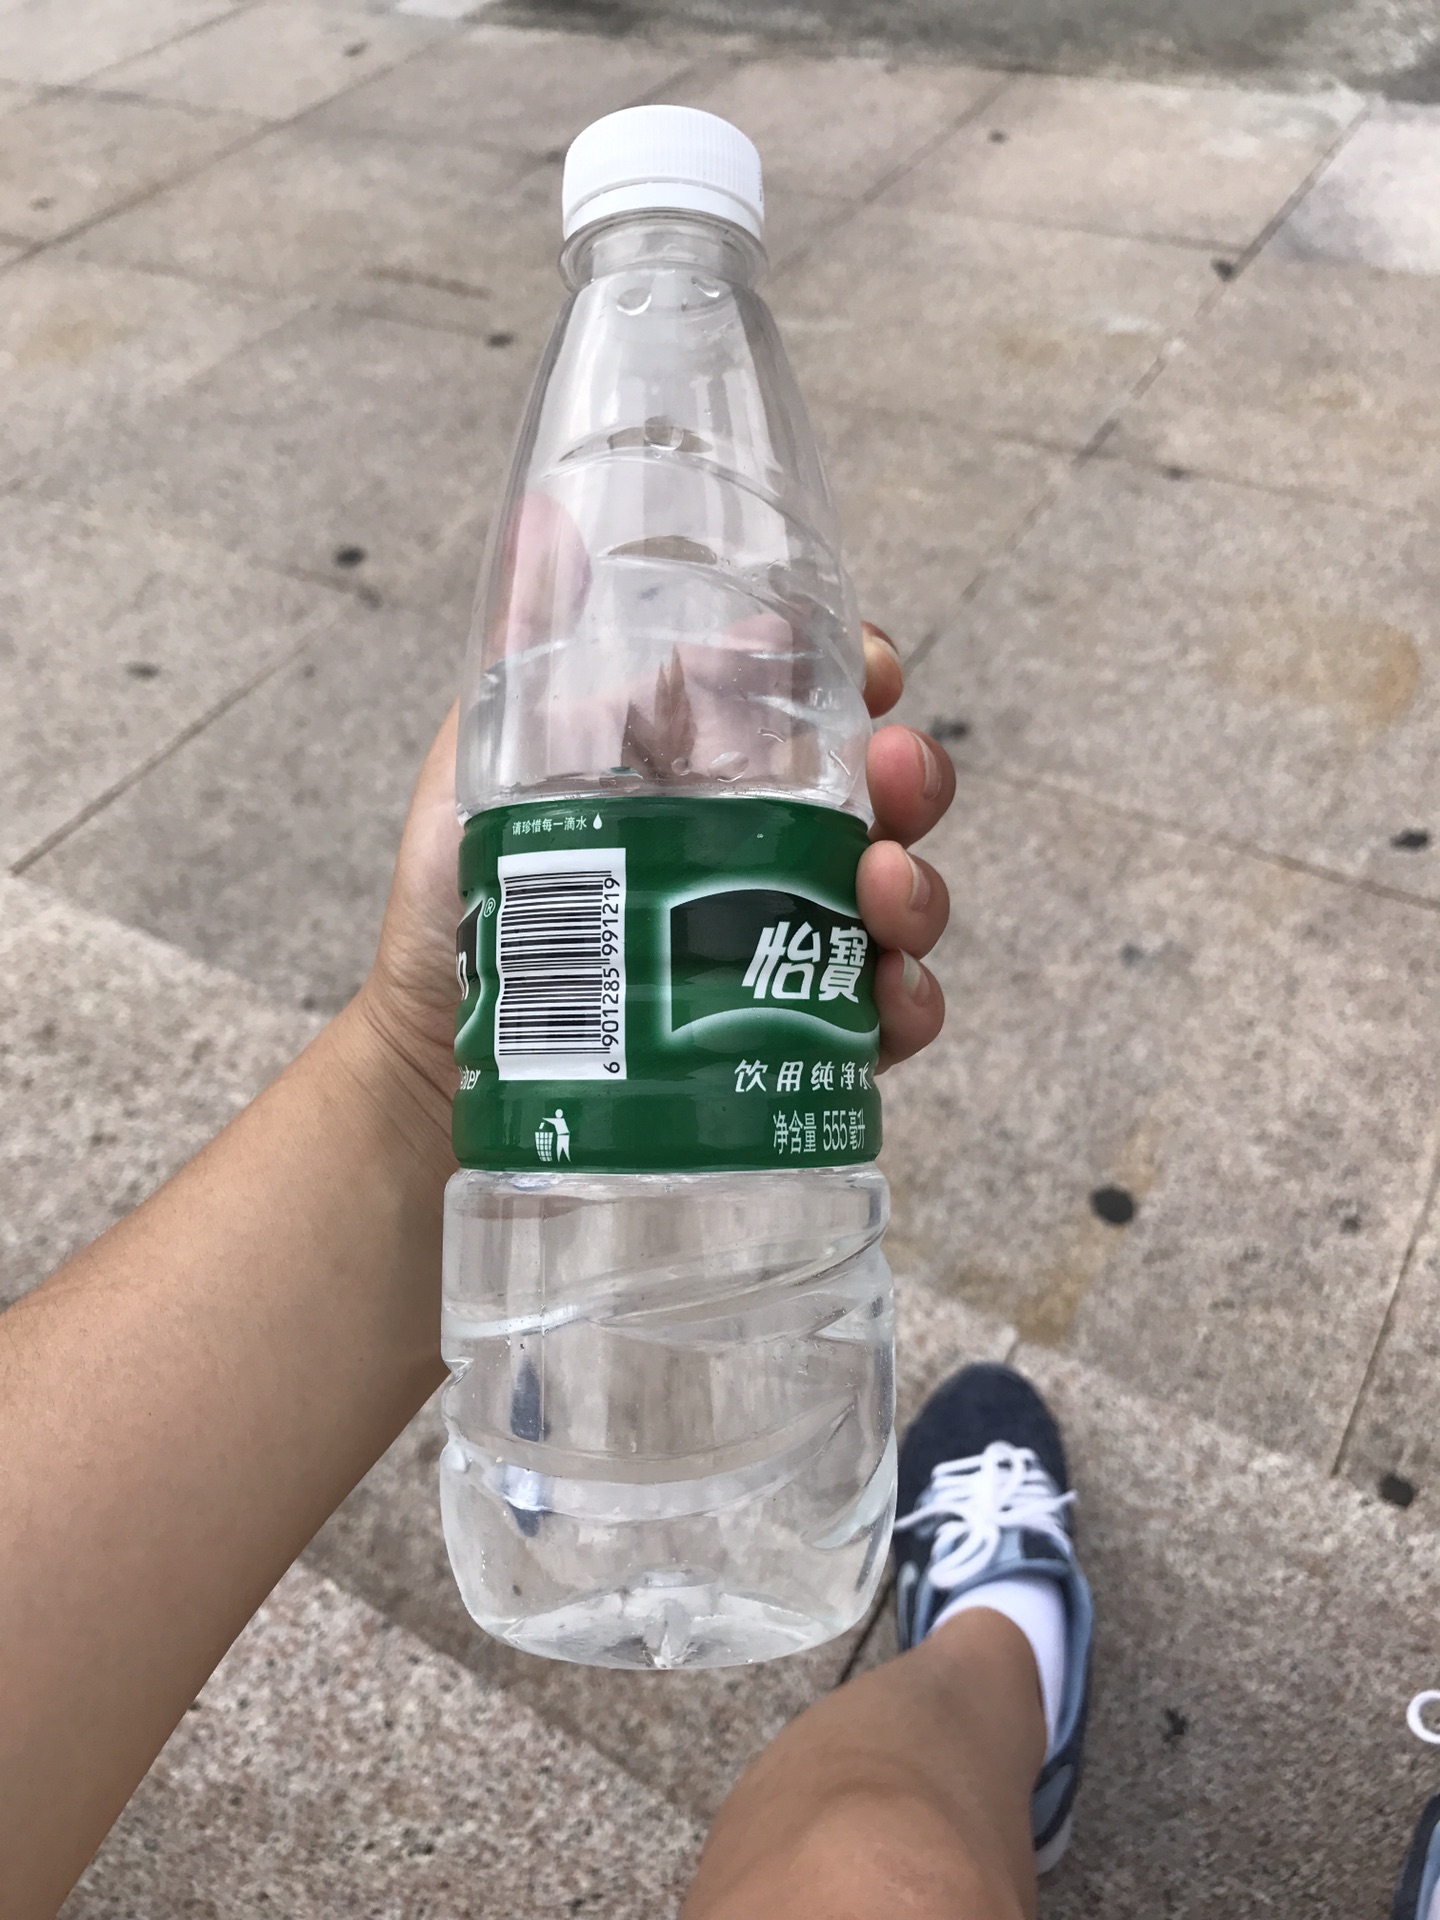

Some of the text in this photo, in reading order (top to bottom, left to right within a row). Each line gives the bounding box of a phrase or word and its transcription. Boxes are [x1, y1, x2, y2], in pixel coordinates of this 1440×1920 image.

[512, 815, 587, 835] 请珍惜每一滴水
[741, 920, 868, 1004] 怡寶
[734, 1058, 872, 1093] 饮用纯净水
